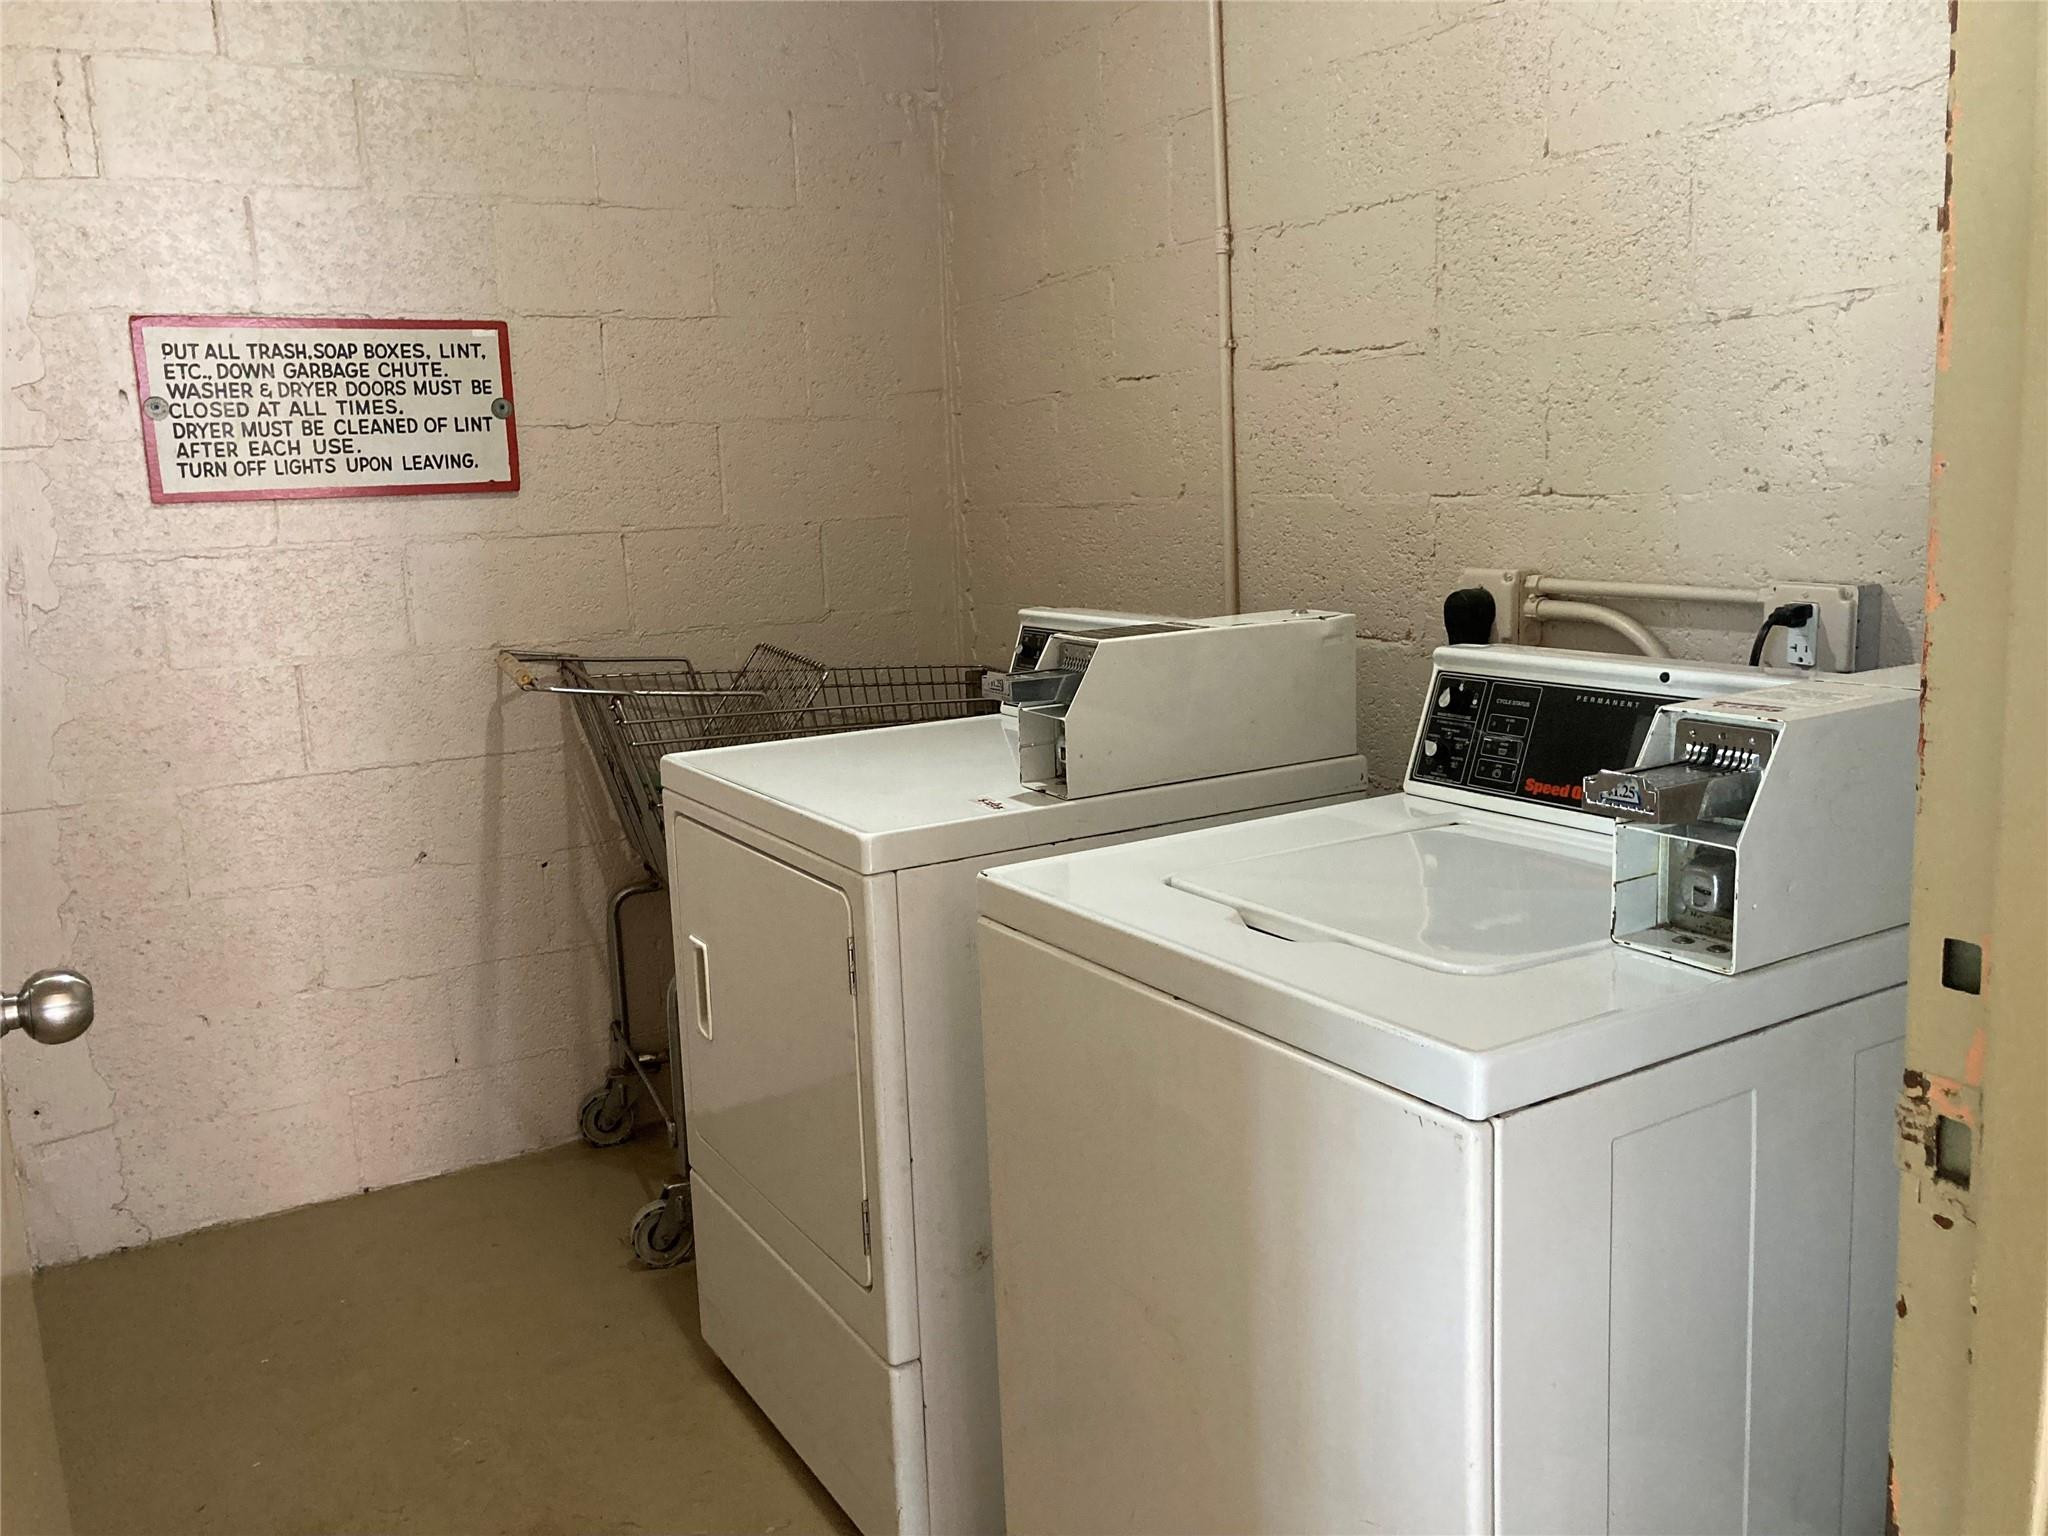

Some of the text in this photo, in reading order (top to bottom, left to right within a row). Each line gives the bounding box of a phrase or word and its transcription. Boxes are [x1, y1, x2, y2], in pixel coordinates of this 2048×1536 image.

[161, 343, 199, 360] PUT
[205, 343, 240, 360] ALL
[364, 343, 431, 360] BOXES,
[439, 343, 486, 360] LINT,
[216, 363, 275, 379] DOWN
[283, 362, 370, 379] GARBAGE
[378, 362, 448, 378] CHUTE.
[166, 379, 492, 399] WASHER & DRYER DOORS MUST BE
[169, 399, 404, 419] CLOSED AT ALL TIMES.
[172, 416, 493, 439] DRYER MUST BE CLEANED OF LINT
[176, 438, 361, 458] AFTER EACH USE.
[176, 453, 479, 478] TURN OFF LIGHTS UPON LEAVING.
[1576, 695, 1640, 708] PERMANENT
[1524, 777, 1569, 799] Speed
